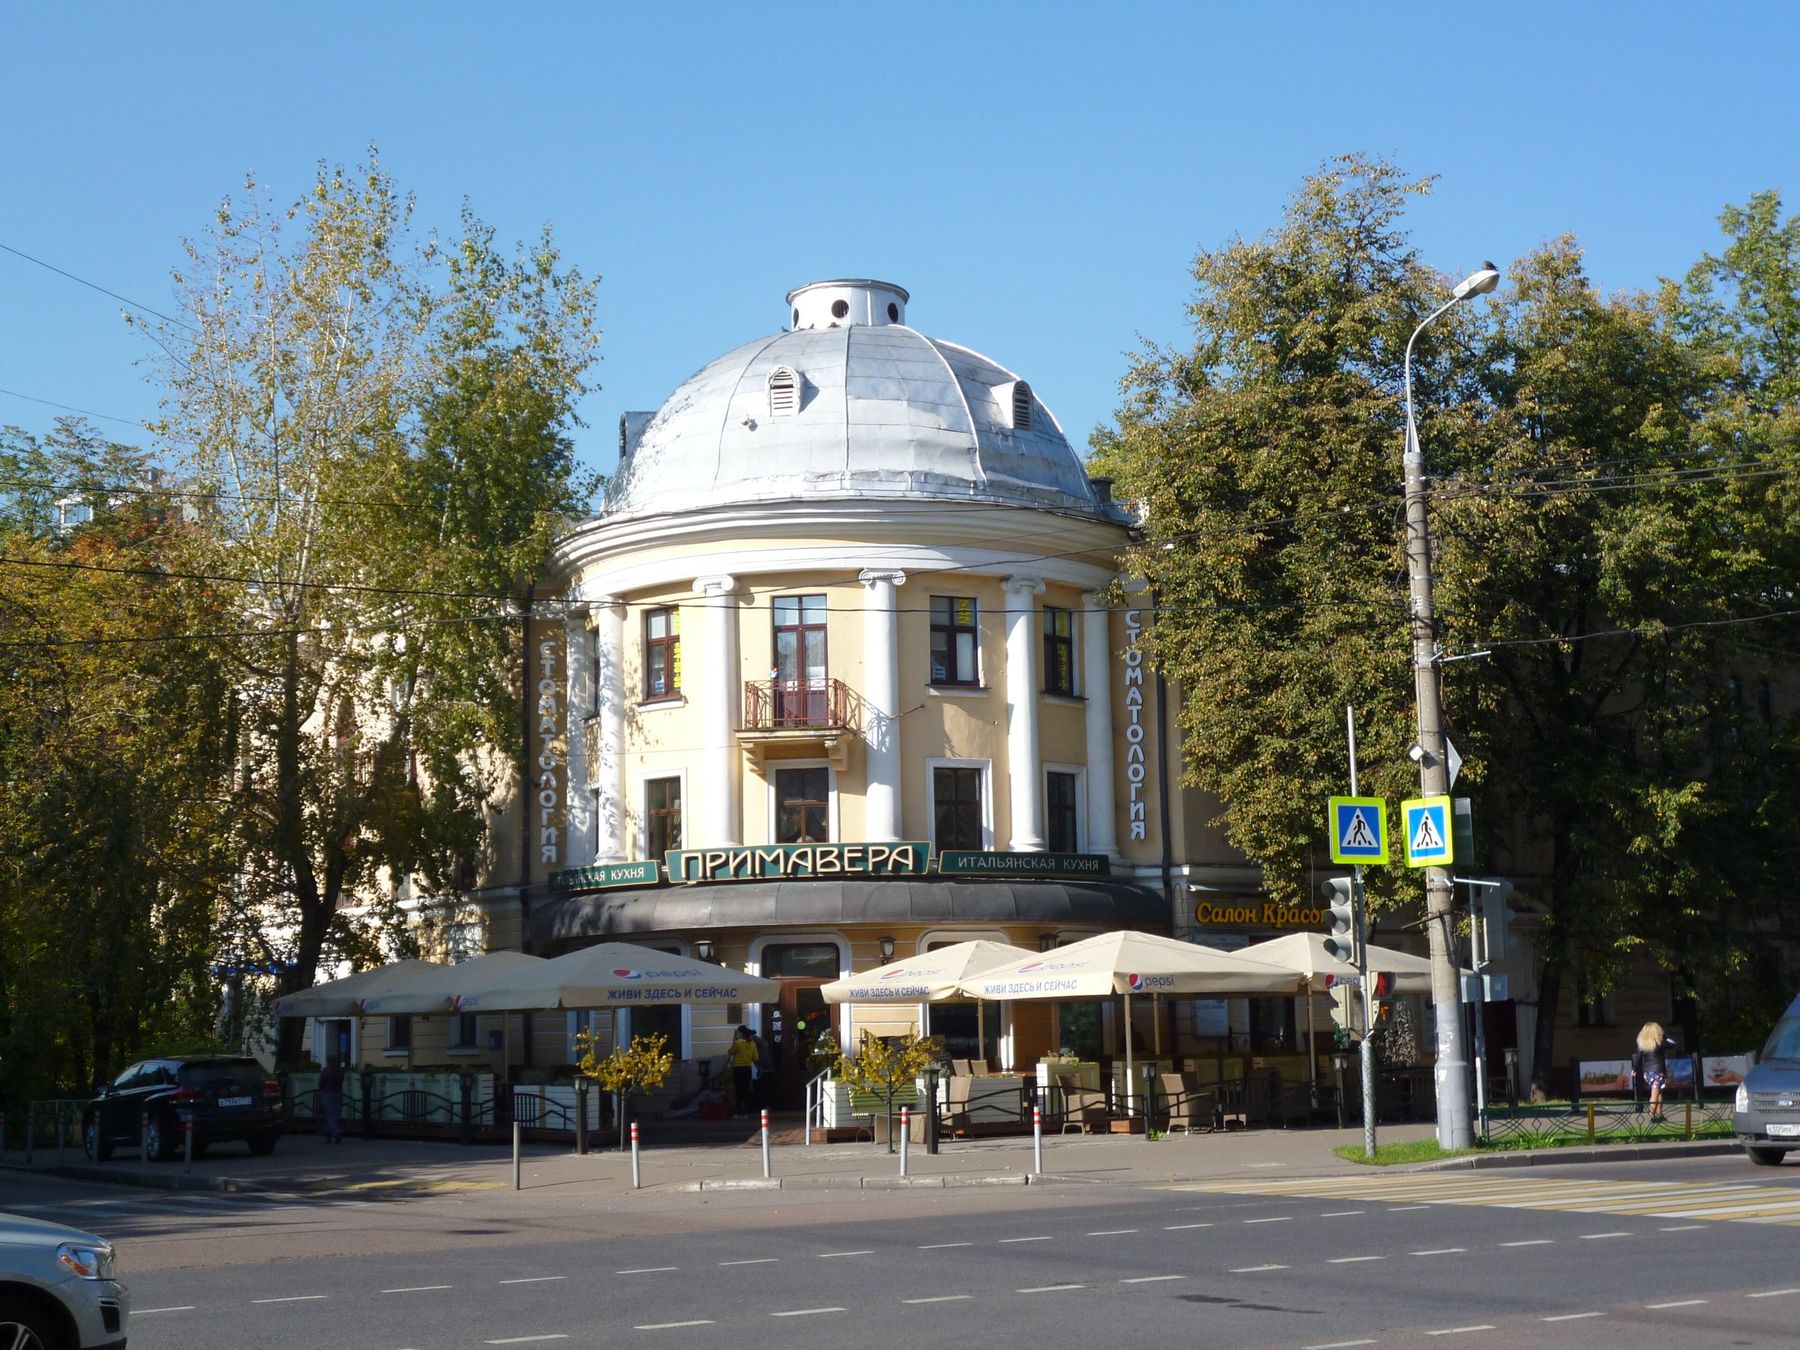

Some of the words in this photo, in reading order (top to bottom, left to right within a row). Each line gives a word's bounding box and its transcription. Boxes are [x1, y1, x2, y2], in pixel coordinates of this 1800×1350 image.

[1125, 611, 1146, 840] СТОМАТОЛОГИЯ
[680, 846, 914, 878] ПРИМАВЕРА
[958, 856, 1055, 870] ИТАЛЬЯНСКАЯ
[1063, 858, 1099, 871] КУХНЯ
[611, 867, 645, 881] КУХНЯ
[1196, 902, 1257, 924] Салон
[984, 983, 1007, 995] ЖИВИ
[1008, 982, 1035, 995] ЗДЕСЬ
[1036, 981, 1042, 991] И
[1044, 979, 1078, 991] СЕЙЧАС
[1145, 975, 1175, 989] pepsi
[608, 989, 641, 1000] ЖИВИ
[644, 988, 681, 1000] ЗДЕСЬ
[684, 988, 692, 998] И
[695, 987, 737, 998] СЕЙЧАС
[848, 987, 870, 998] ЖИВИ
[870, 987, 894, 998] ЗДЕСЬ
[895, 987, 900, 997] И
[901, 985, 930, 997] СЕЙЧАС
